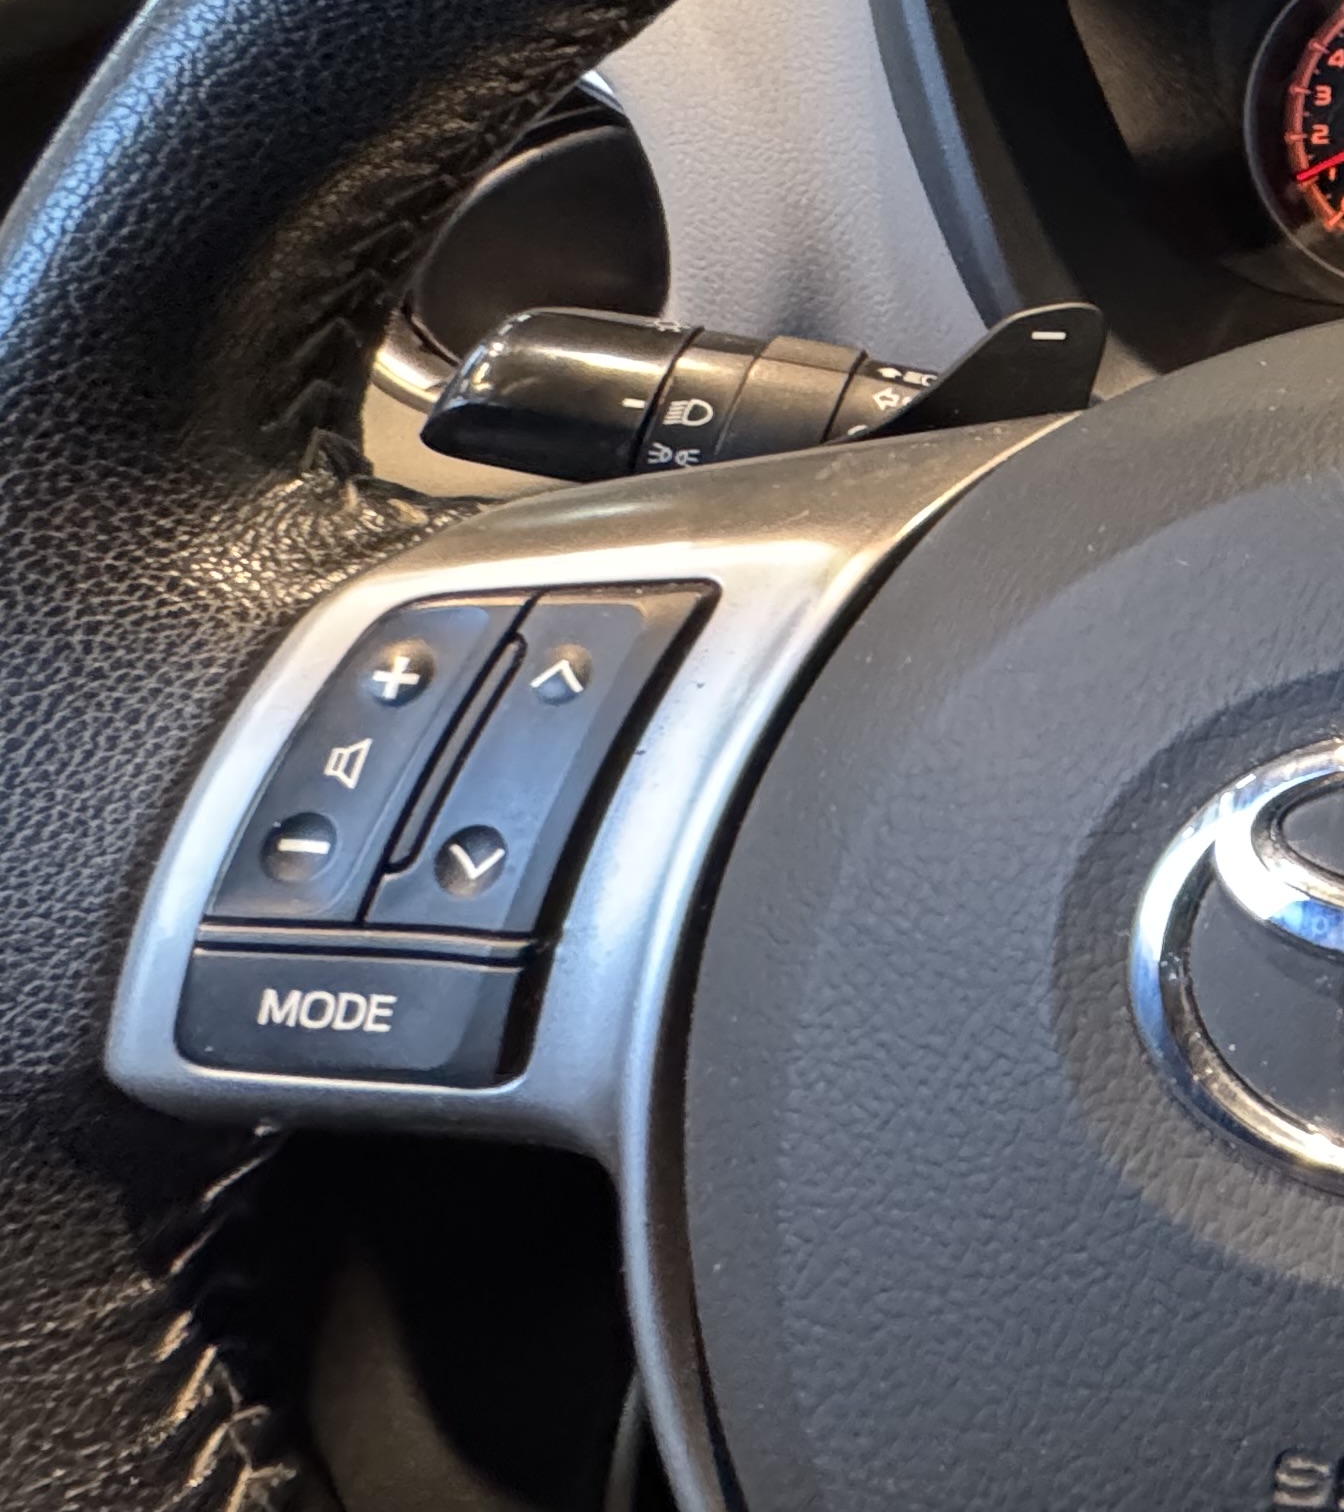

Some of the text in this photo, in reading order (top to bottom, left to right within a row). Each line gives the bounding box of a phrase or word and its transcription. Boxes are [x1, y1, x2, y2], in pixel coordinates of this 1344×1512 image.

[1314, 85, 1332, 106] 3
[1311, 124, 1330, 145] 2
[256, 987, 399, 1033] MODE
